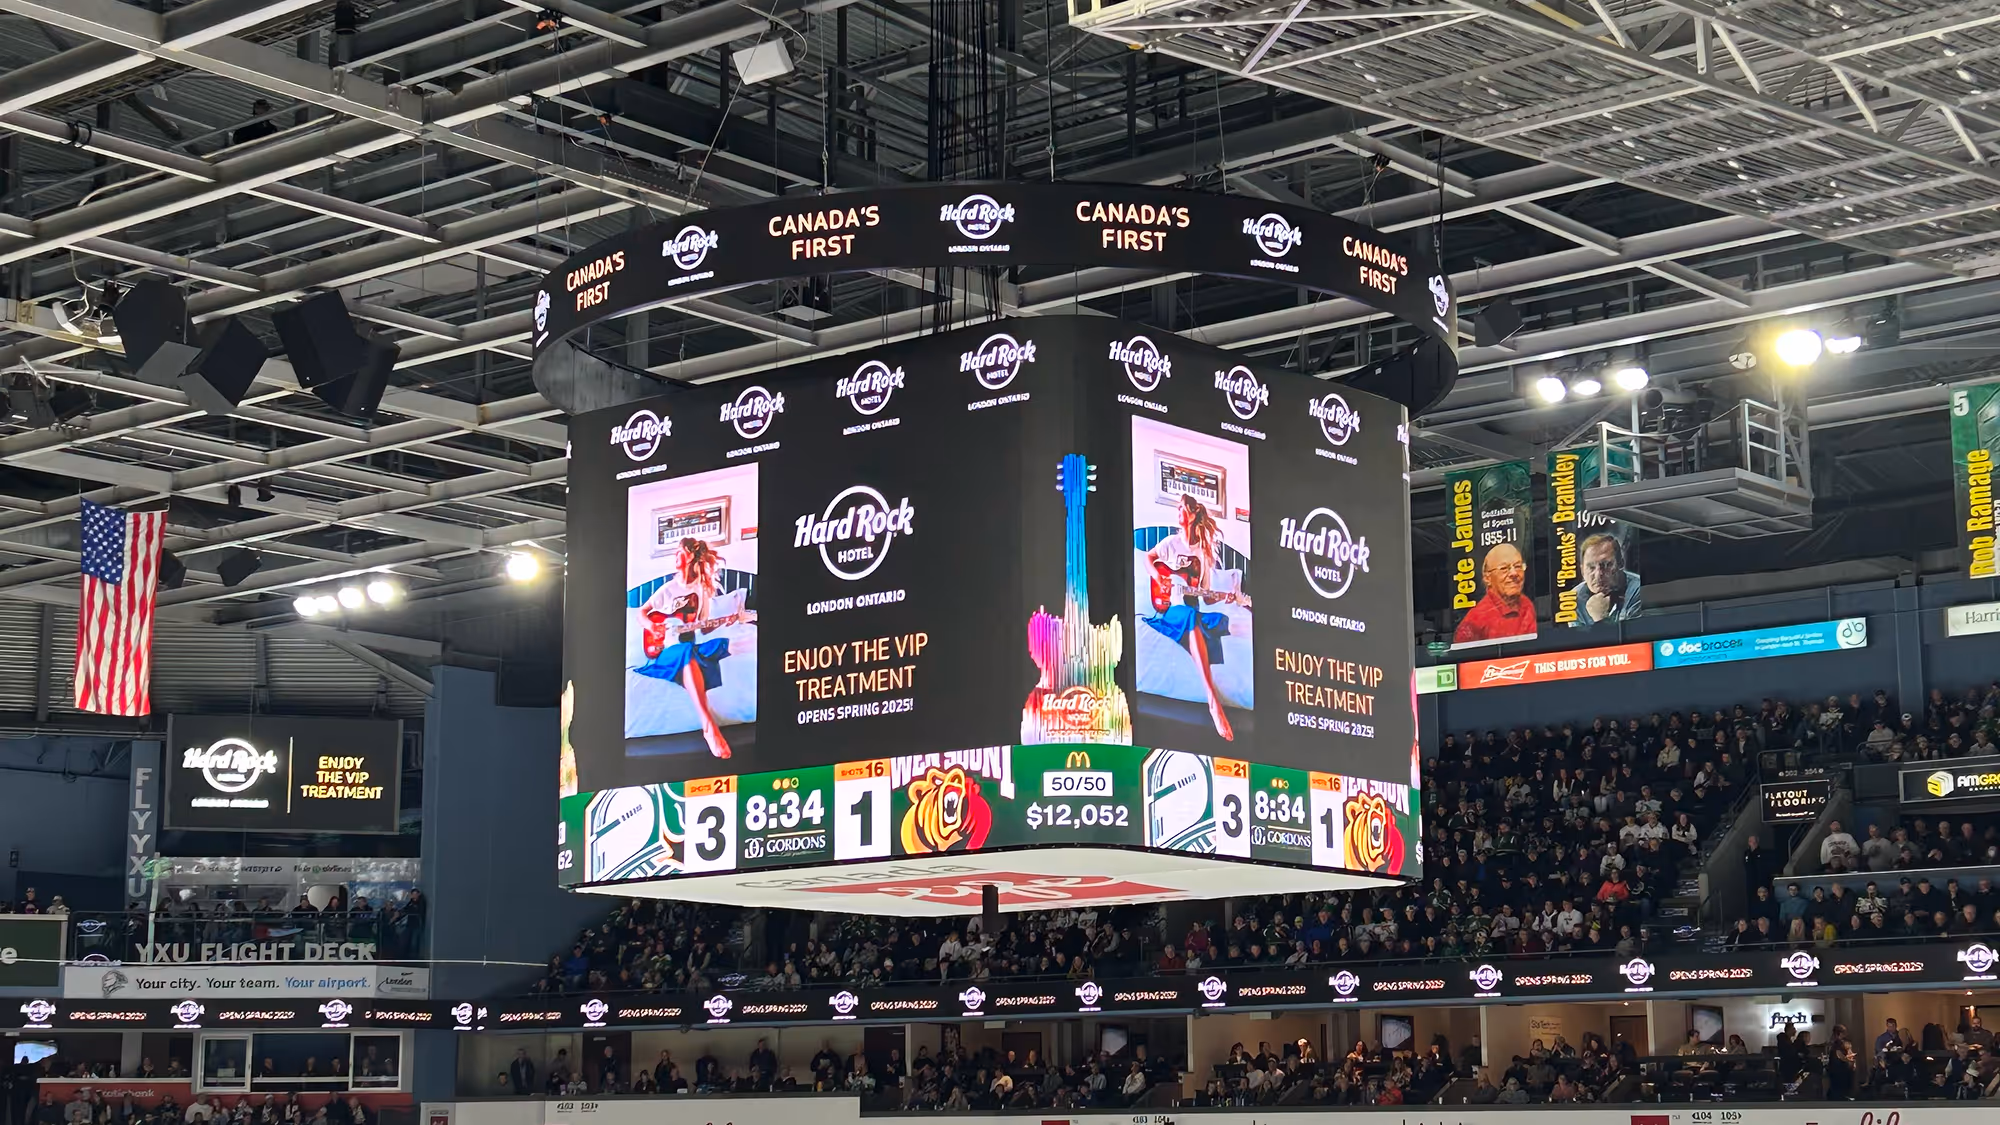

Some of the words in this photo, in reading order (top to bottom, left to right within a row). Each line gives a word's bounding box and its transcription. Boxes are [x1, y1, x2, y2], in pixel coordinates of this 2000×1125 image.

[769, 206, 880, 236] CANADA'S
[940, 204, 978, 222] Hard
[979, 203, 1015, 223] Rock
[1076, 202, 1190, 228] CANADA'S
[662, 235, 690, 256] Hard
[690, 230, 718, 252] Rock
[1103, 230, 1166, 252] FIRST
[1243, 218, 1274, 238] Hard
[1274, 224, 1302, 245] Rock
[792, 235, 855, 260] FIRST
[1343, 236, 1408, 276] CANADA'S
[566, 251, 625, 292] CANADA'S
[1360, 266, 1397, 294] FIRST
[576, 281, 610, 311] FIRST
[960, 348, 996, 372] Hard
[996, 340, 1036, 367] Rock
[1109, 341, 1143, 365] Hard
[1143, 349, 1172, 378] Rock
[836, 373, 871, 398] Hard
[872, 366, 905, 392] Rock
[1214, 370, 1243, 395] Hard
[1243, 378, 1269, 406] Rock
[720, 399, 751, 422] Hard
[751, 392, 785, 416] Rock
[1309, 398, 1336, 421] Hard
[1336, 406, 1360, 432] Rock
[1953, 390, 1970, 416] 5
[610, 422, 642, 445] Hard
[642, 416, 672, 441] Rock
[1552, 453, 1580, 524] Brankley
[1967, 448, 1994, 532] Ramage
[794, 506, 856, 548] Hard
[856, 497, 915, 542] Rock
[1452, 479, 1474, 552] James
[1280, 518, 1327, 558] Hard
[1327, 529, 1370, 573] Rock
[1481, 528, 1517, 546] 1955-11
[837, 546, 874, 563] HOTEL
[1969, 536, 1996, 577] Rob
[1315, 566, 1342, 583] HOTEL
[1453, 558, 1476, 610] Pete
[807, 598, 854, 615] LONDON
[856, 589, 906, 608] ONTARIO
[1555, 590, 1577, 623] Don
[1292, 608, 1328, 626] LONDON
[1329, 614, 1366, 633] ONTARIO
[784, 645, 847, 674] ENJOY
[851, 638, 890, 665] THE
[897, 632, 928, 658] VIP
[1534, 662, 1556, 674] THIS
[1557, 659, 1586, 671] BUD'S
[1588, 657, 1607, 668] FOR
[1607, 654, 1631, 666] YOU.
[1276, 648, 1324, 677] ENJOY
[1327, 658, 1356, 682] THE
[1359, 665, 1383, 688] VIP
[1438, 671, 1454, 684] TD
[796, 665, 916, 701] TREATMENT
[797, 708, 835, 724] OPENS
[837, 702, 880, 720] SPRING
[882, 698, 914, 714] 2025!
[1042, 694, 1078, 710] Hard
[1286, 681, 1375, 716] TREATMENT
[1288, 712, 1316, 730] OPENS
[1318, 717, 1350, 735] SPRING
[1351, 722, 1375, 739] 2025!
[316, 770, 342, 784] THE
[346, 772, 369, 784] VIP
[318, 756, 364, 770] ENJOY
[865, 762, 884, 777] 16
[1234, 764, 1246, 777] 21
[301, 785, 383, 800] TREATMENT
[713, 778, 731, 793] 21
[1051, 776, 1106, 792] 50/50
[1328, 778, 1341, 790] 16
[1765, 790, 1807, 800] FLATOUT
[745, 789, 824, 831] 8:34
[851, 791, 872, 846] 1
[1026, 802, 1129, 830] $12,052
[1223, 794, 1243, 837] 3
[1255, 790, 1306, 825] 8:34
[696, 806, 726, 861] 3
[1267, 831, 1312, 847] GORDONS
[1321, 808, 1333, 848] 1
[767, 835, 826, 853] GORDONS
[136, 943, 190, 963] YXU
[201, 943, 295, 961] FLIGHT
[304, 942, 376, 962] DECK
[136, 978, 166, 990] Your
[169, 977, 200, 992] city.
[206, 977, 237, 989] Your
[240, 977, 280, 989] team.
[286, 976, 316, 988] Your
[318, 976, 371, 991] airport.
